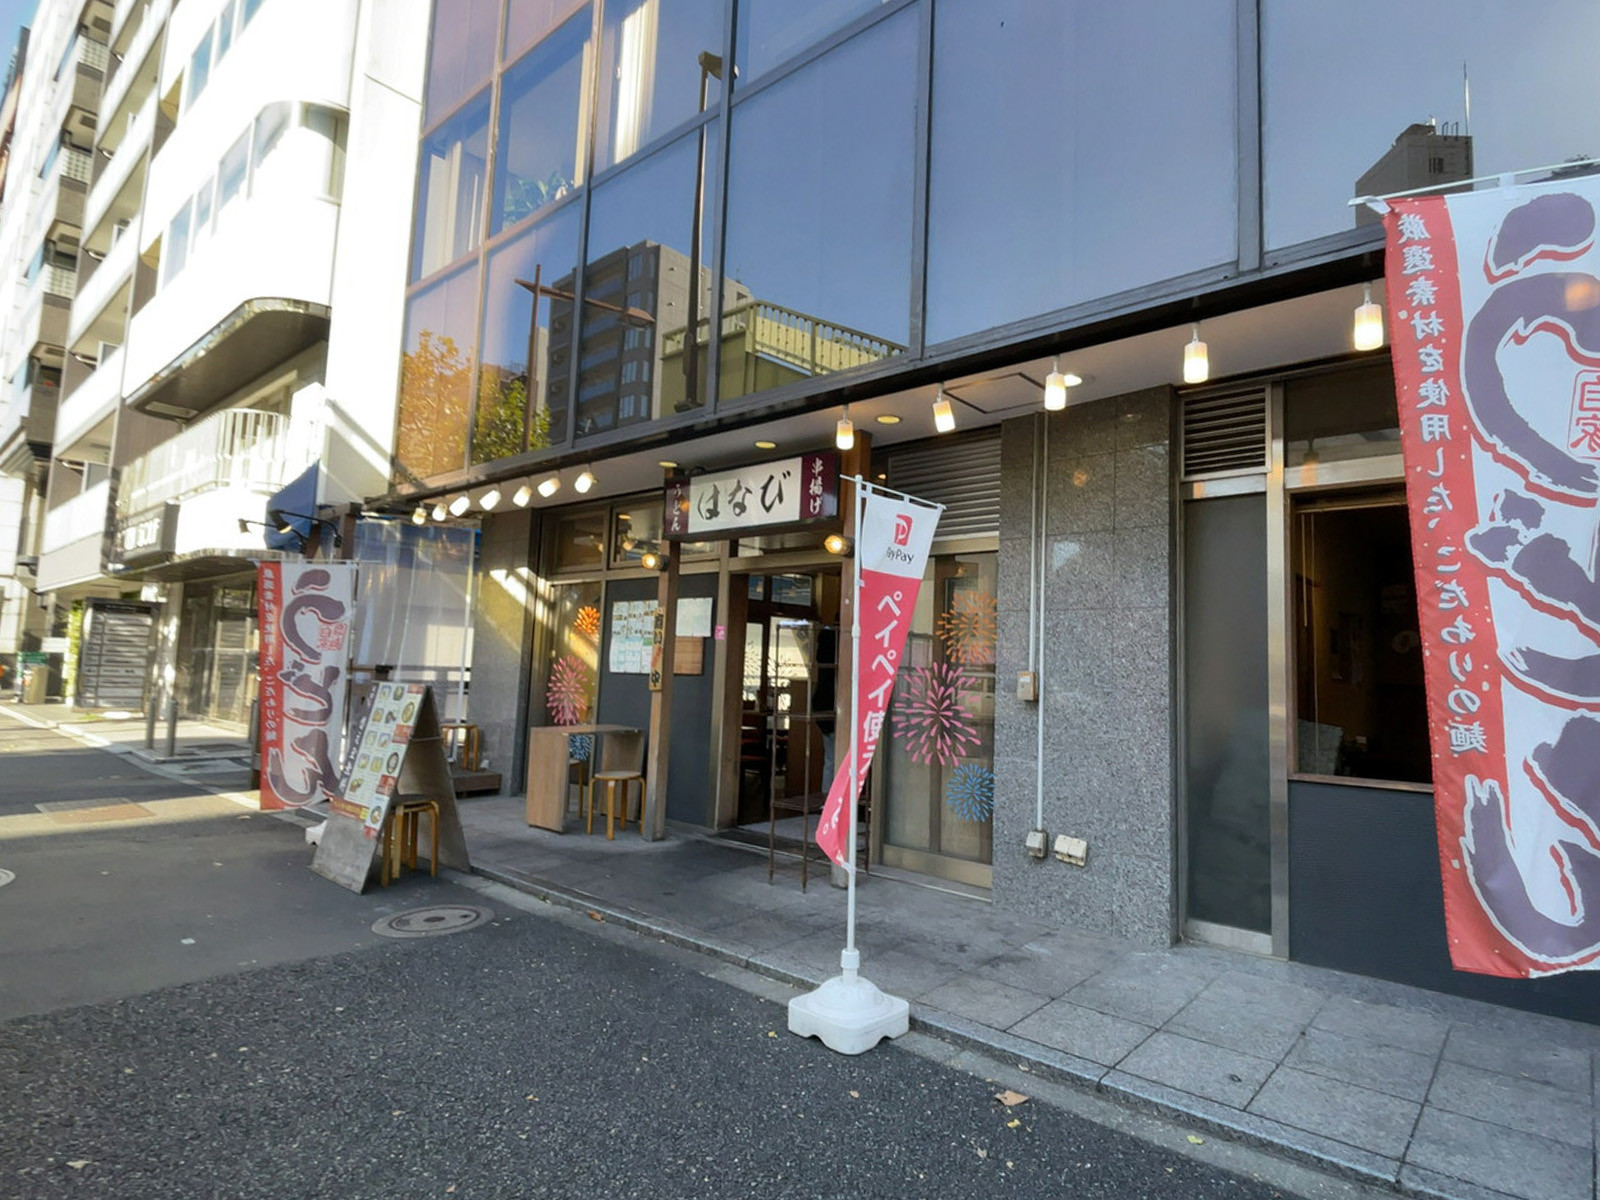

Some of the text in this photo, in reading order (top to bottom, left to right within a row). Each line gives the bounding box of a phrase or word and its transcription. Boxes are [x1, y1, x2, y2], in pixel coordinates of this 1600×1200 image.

[670, 483, 682, 532] うどん
[697, 470, 792, 520] はなび
[808, 456, 824, 514] 串揚げ
[884, 547, 916, 565] ayPay
